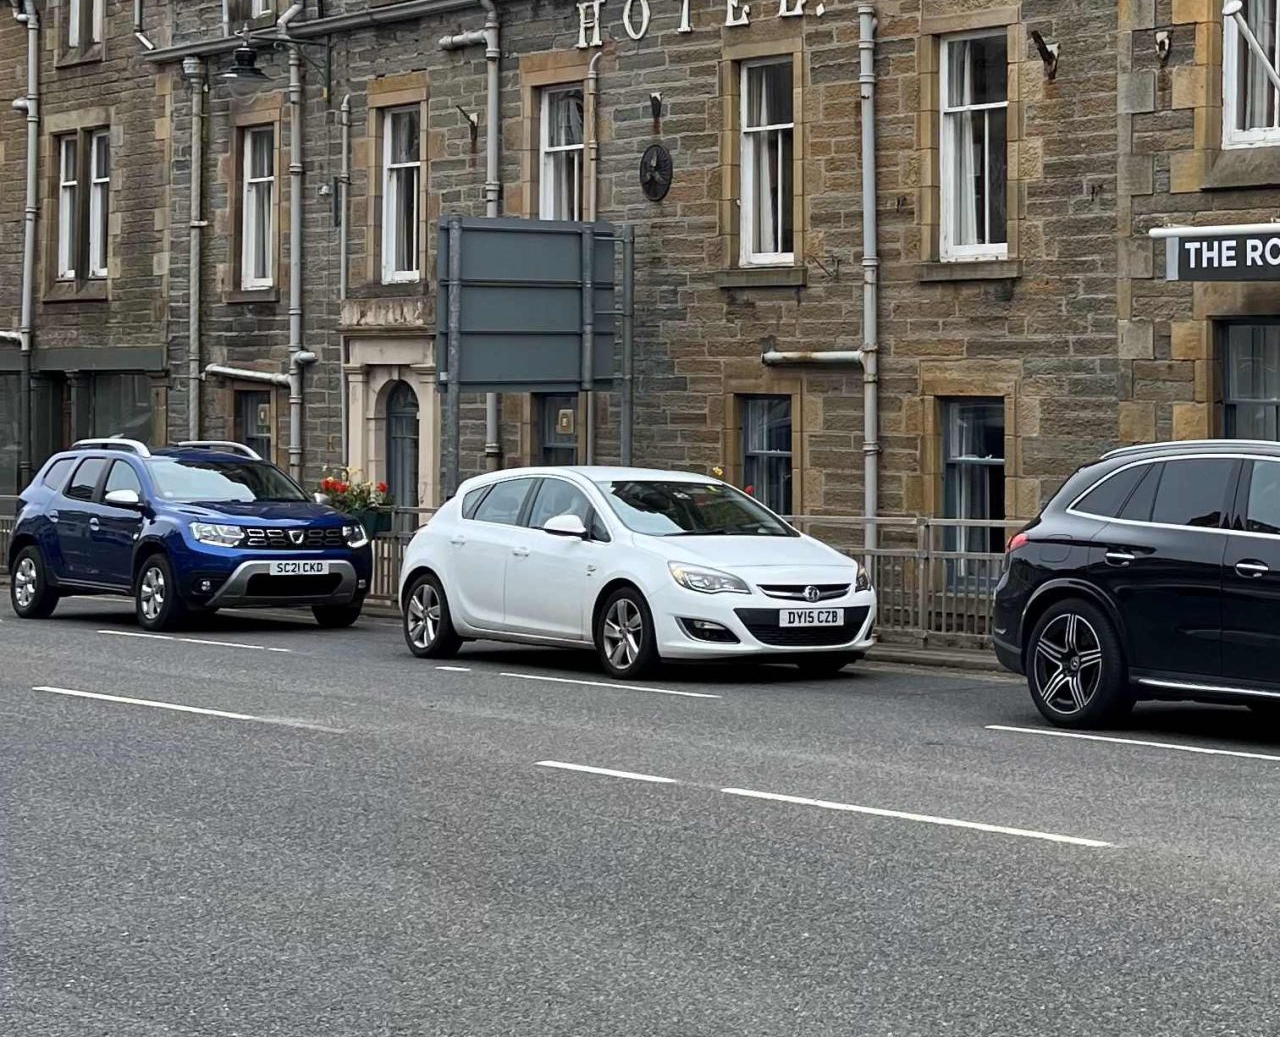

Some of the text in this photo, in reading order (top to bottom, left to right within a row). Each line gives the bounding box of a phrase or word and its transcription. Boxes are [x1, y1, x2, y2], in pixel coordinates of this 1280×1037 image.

[1185, 240, 1237, 268] THE
[277, 562, 323, 573] SC21 CKD
[788, 610, 838, 624] DY15 CZB
